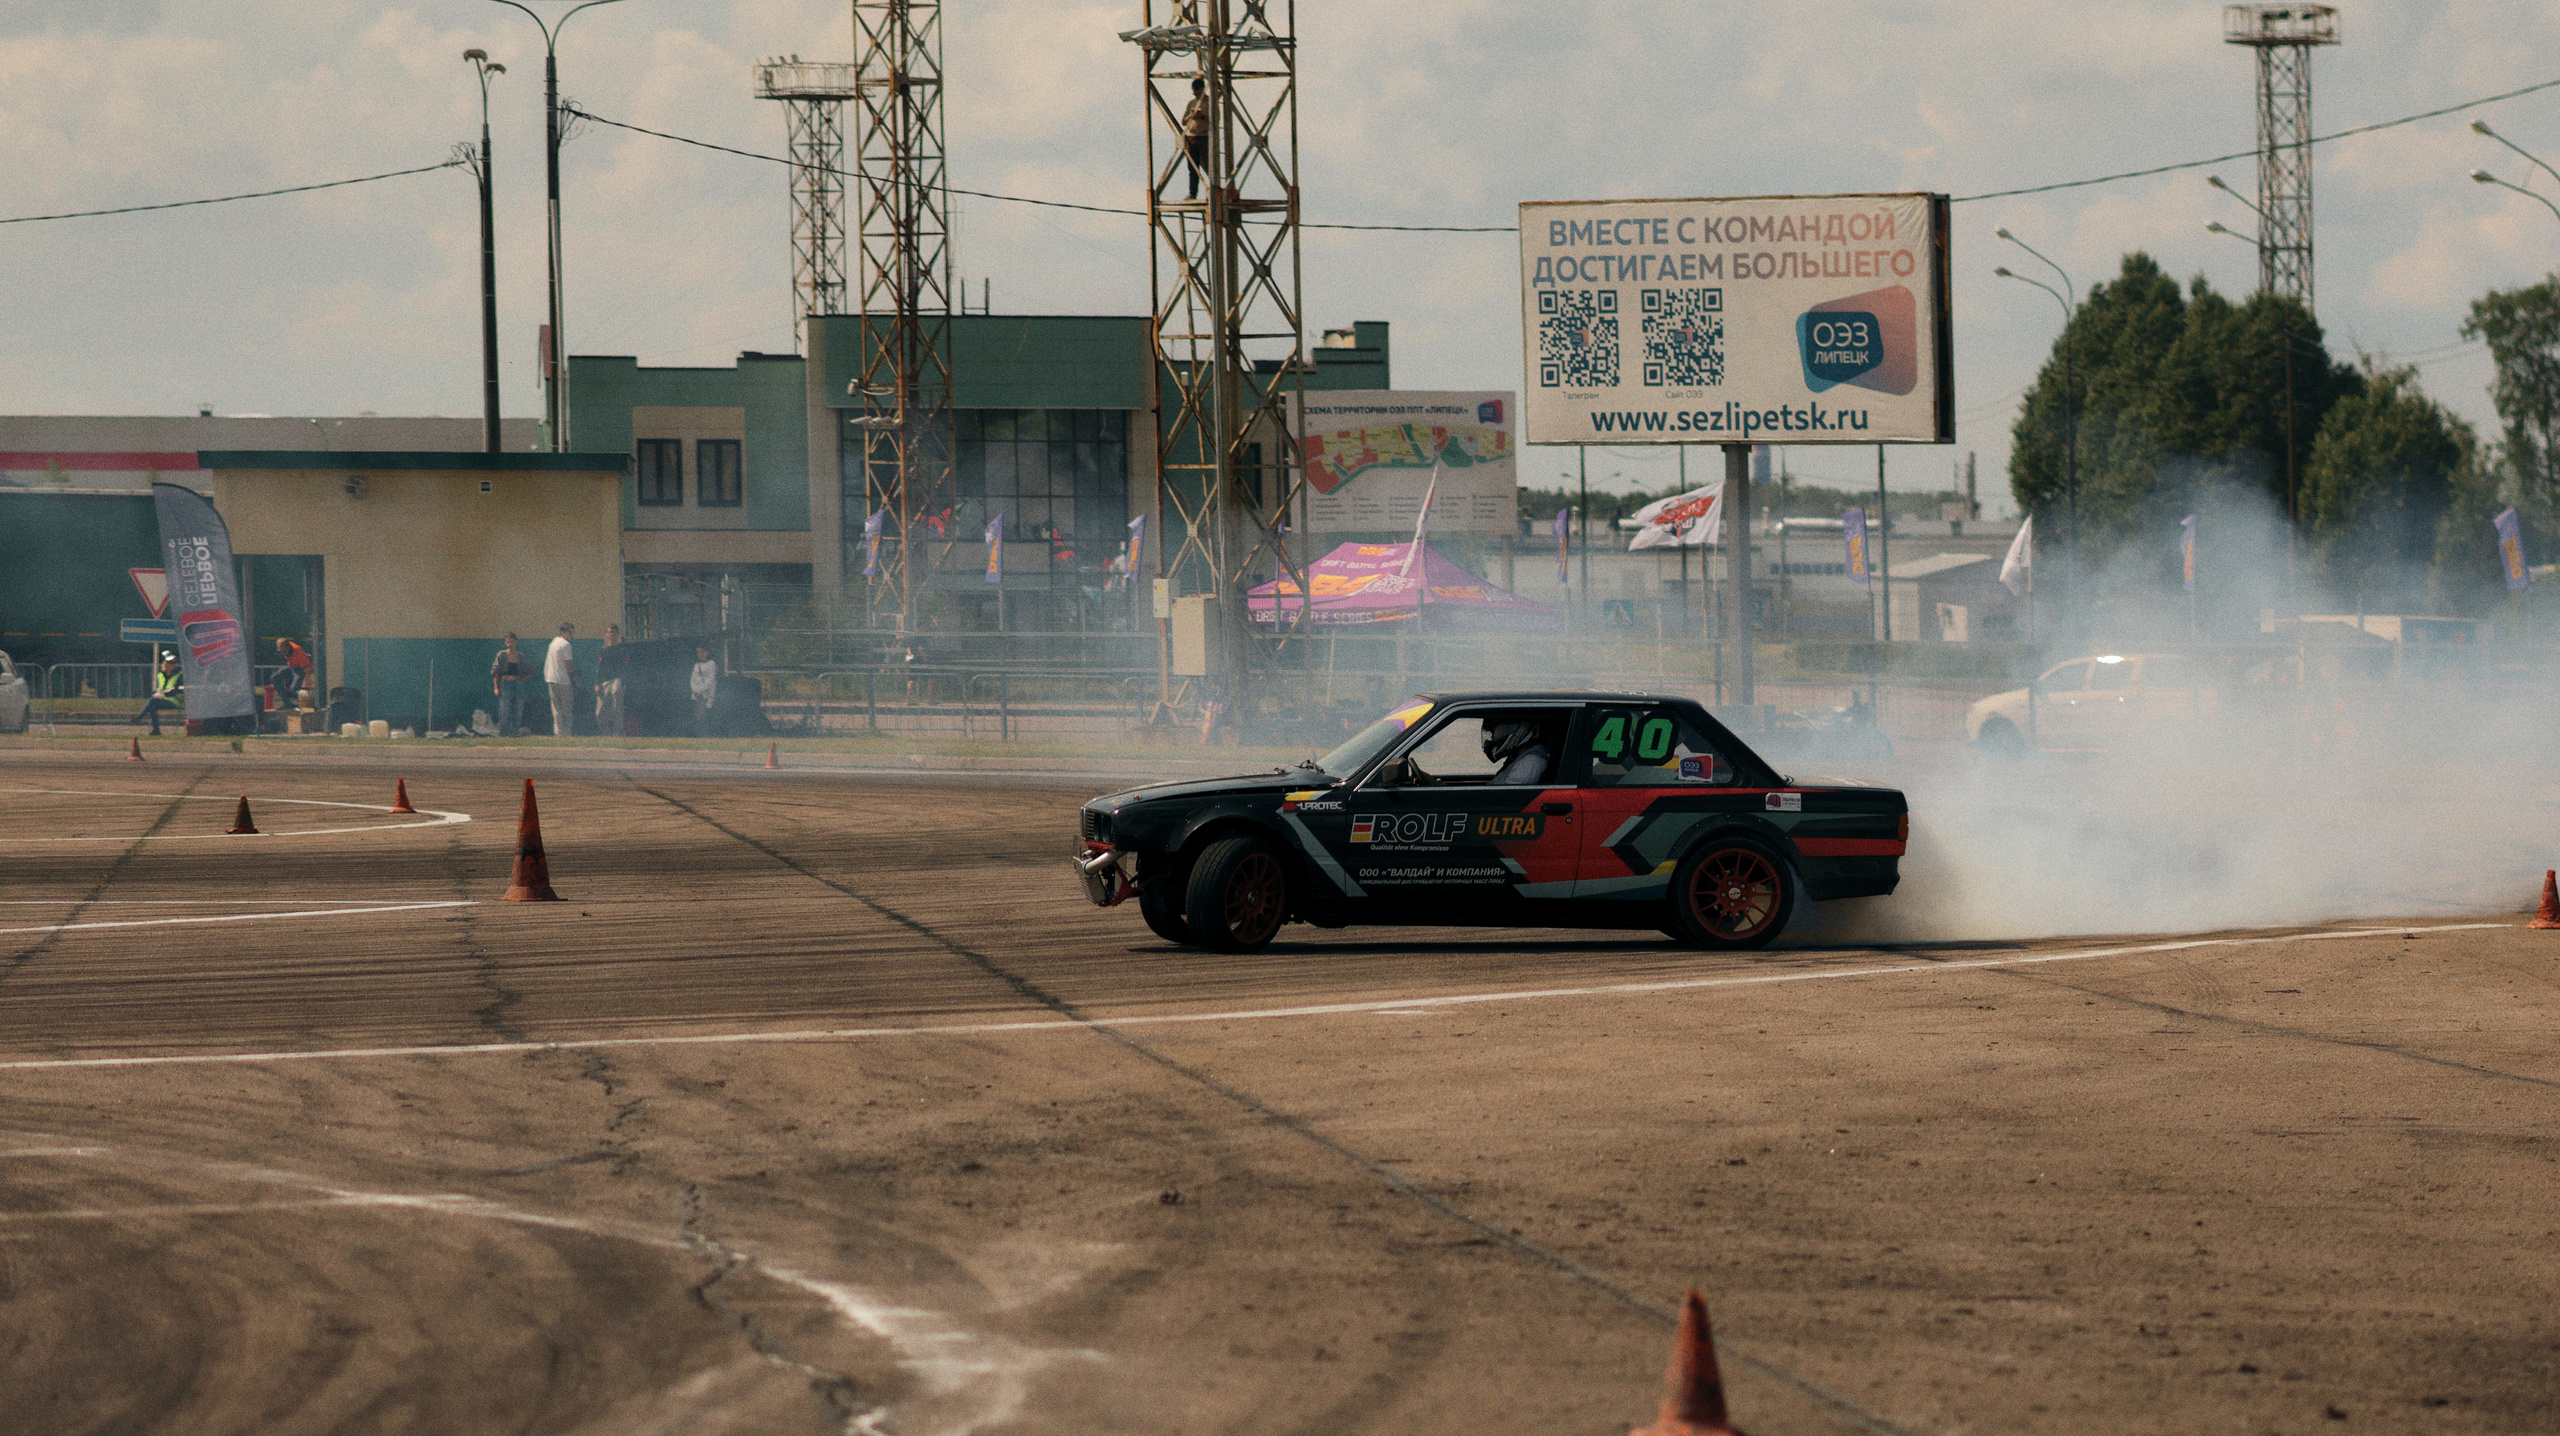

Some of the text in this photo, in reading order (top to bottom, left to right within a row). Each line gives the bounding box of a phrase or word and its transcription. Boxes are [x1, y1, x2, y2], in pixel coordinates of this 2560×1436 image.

[1550, 206, 1896, 246] ВМЕСТЕ С КОМАНДОЙ
[1532, 249, 1916, 288] ДОСТИГАЕМ БОЛЬШЕГО
[1813, 321, 1869, 348] ОЭЗ
[1813, 350, 1870, 366] ЛИПЕЦК
[1590, 401, 1869, 438] www.sezlipetsk.ru
[1591, 717, 1674, 759] 40
[1371, 813, 1537, 843] ROLF ULTRA
[1359, 868, 1379, 877] ООО
[1436, 867, 1445, 877] И
